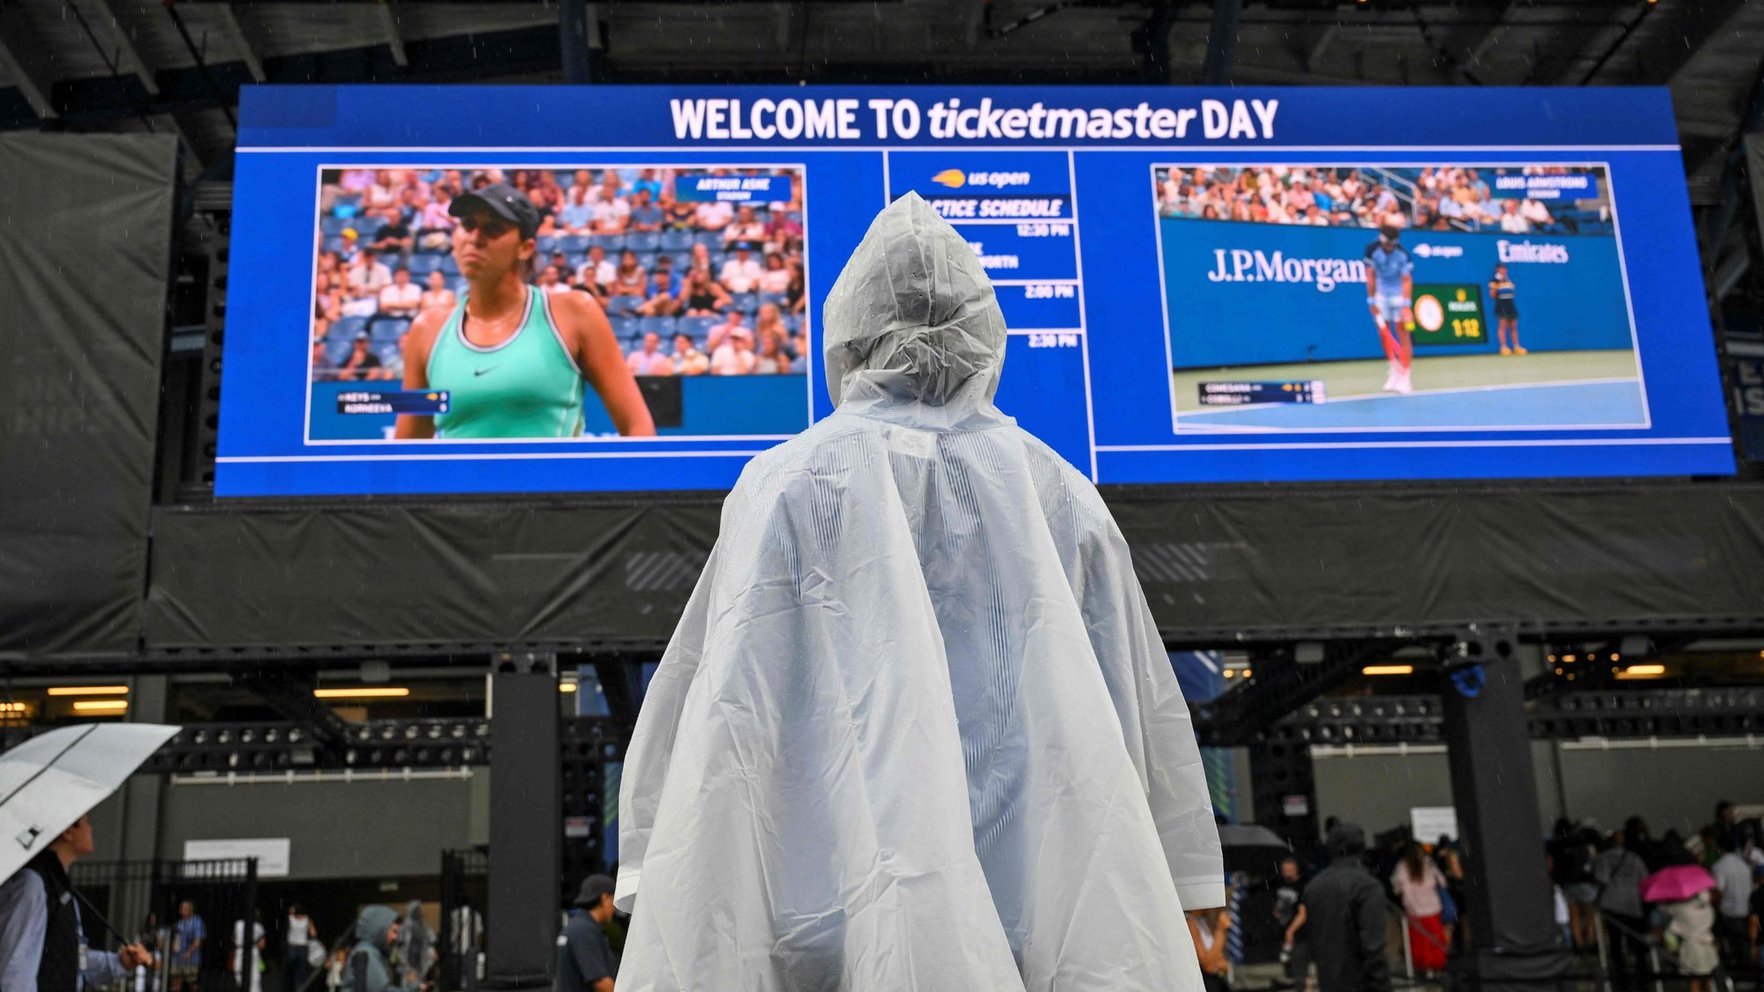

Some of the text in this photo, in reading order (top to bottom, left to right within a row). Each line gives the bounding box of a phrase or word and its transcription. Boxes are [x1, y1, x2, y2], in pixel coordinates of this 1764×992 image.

[670, 98, 1279, 140] WELCOME TO ticketmaster DAY
[696, 178, 770, 190] ARTHUR ASHE
[988, 172, 1030, 188] open
[927, 199, 1062, 217] CTICE SCHEDULE
[1017, 224, 1070, 236] 12:30 PM
[1497, 240, 1569, 263] Emirates
[1025, 285, 1074, 298] 2:00 PM
[1028, 334, 1078, 347] 2:30 PM
